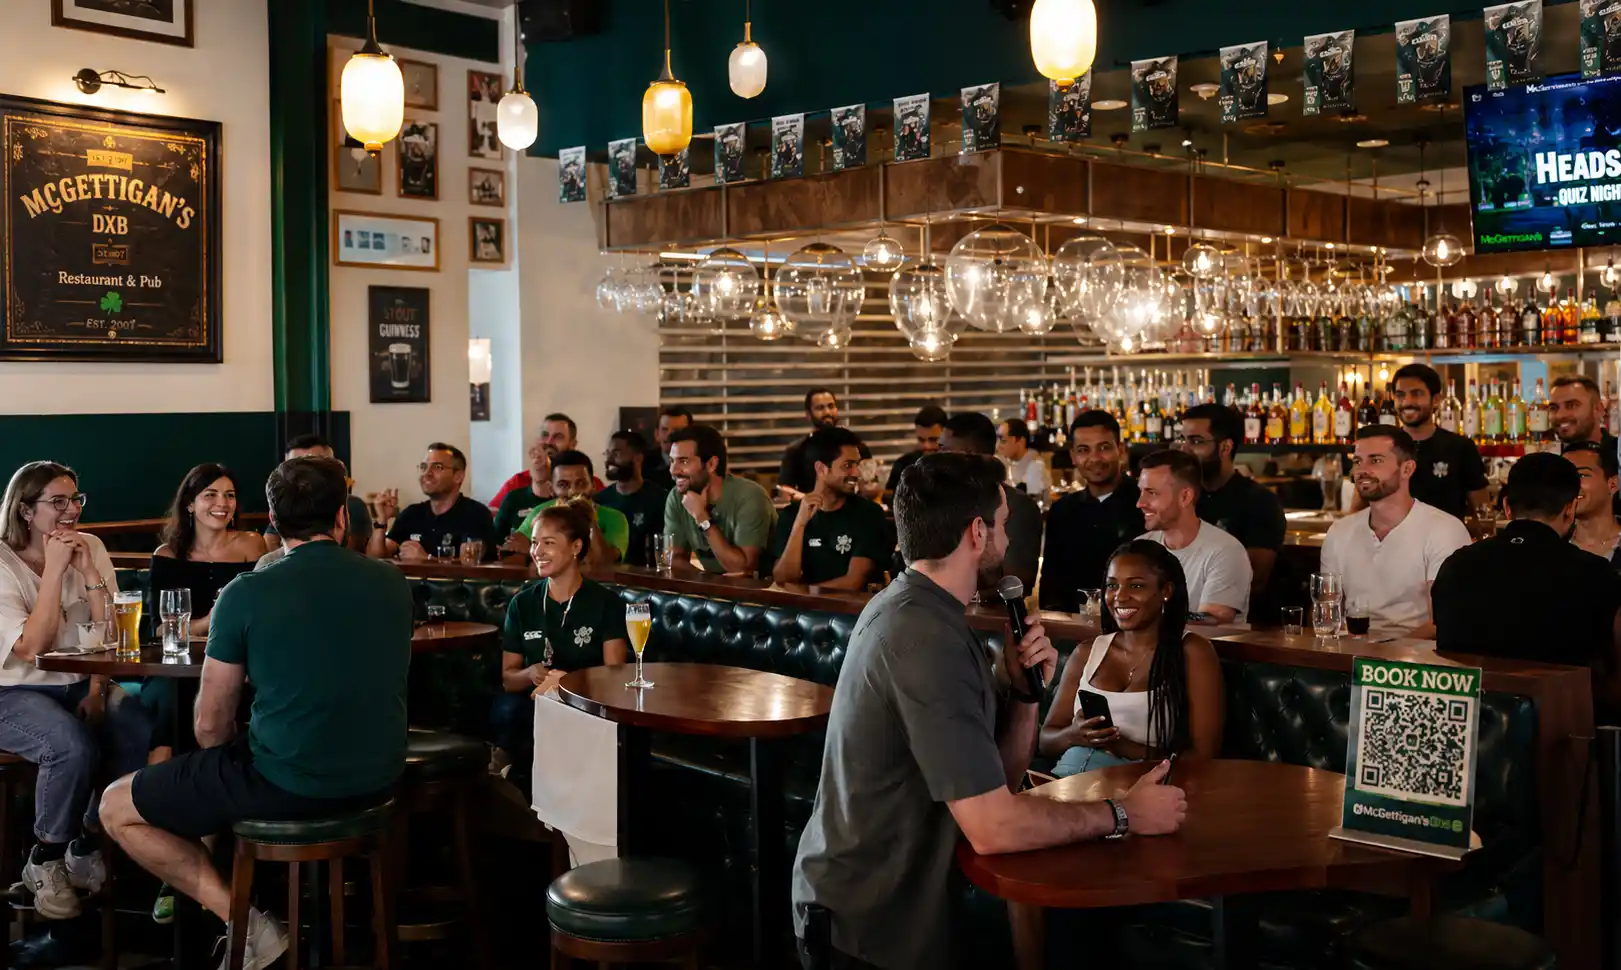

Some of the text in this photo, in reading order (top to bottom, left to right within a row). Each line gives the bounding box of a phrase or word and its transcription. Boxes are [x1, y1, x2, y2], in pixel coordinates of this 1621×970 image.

[1535, 149, 1621, 184] HEADS
[1559, 184, 1621, 206] QUIZ NIGH
[92, 214, 128, 235] DXB
[58, 272, 162, 288] Restaurant & Pub
[379, 323, 420, 338] GUINNESS
[1361, 664, 1474, 693] BOOK NOW
[1364, 806, 1429, 825] McGettigan's
